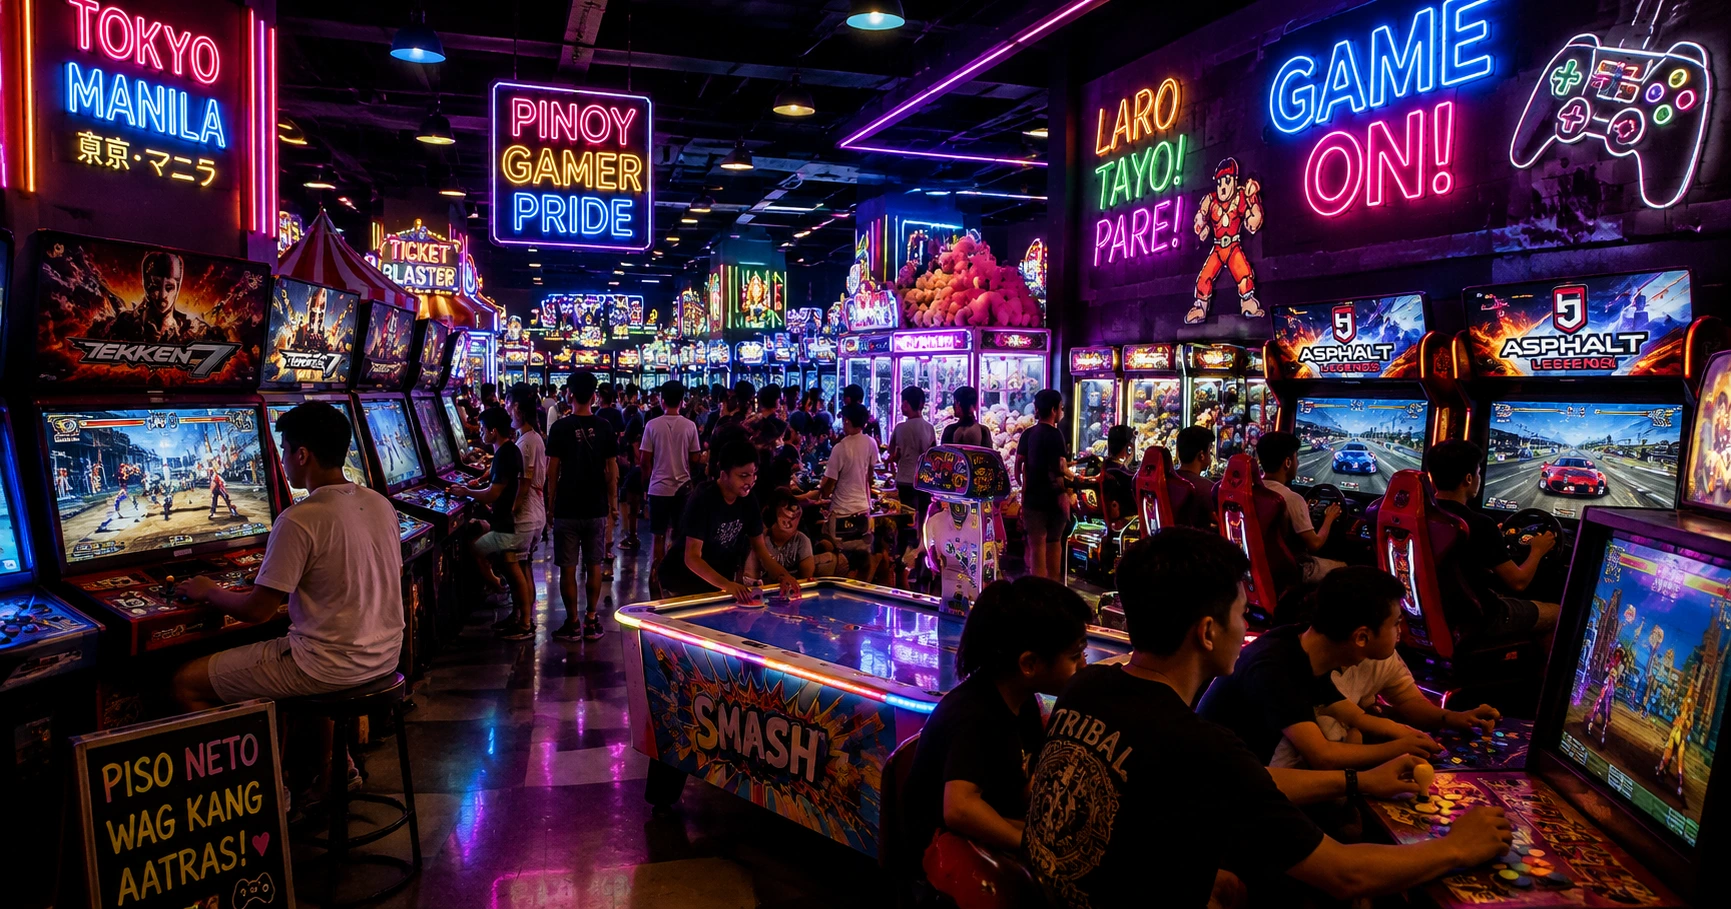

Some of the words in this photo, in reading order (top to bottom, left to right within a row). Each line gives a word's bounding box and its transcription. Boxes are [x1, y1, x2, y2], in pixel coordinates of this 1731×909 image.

[69, 0, 220, 84] TOKYO
[1269, 0, 1493, 133] GAME
[68, 62, 226, 148] MANILA
[512, 97, 637, 145] PINOY
[1095, 78, 1180, 155] LARO
[502, 145, 643, 191] GAMER
[1095, 133, 1187, 210] TAYO!
[1304, 101, 1453, 216] ON!
[513, 192, 633, 237] PRIDE
[1093, 195, 1183, 267] PARE!
[389, 239, 452, 264] TICKET
[79, 342, 193, 364] TEKKEN
[187, 343, 236, 377] 7
[1299, 345, 1393, 361] ASPHALT
[1501, 334, 1646, 356] ASPHALT
[101, 752, 174, 803] PISO
[184, 733, 259, 781] NETO
[693, 694, 820, 783] SMASH
[105, 803, 176, 854] WAG
[186, 780, 263, 832] KANG
[117, 829, 247, 907] AATRAS!
